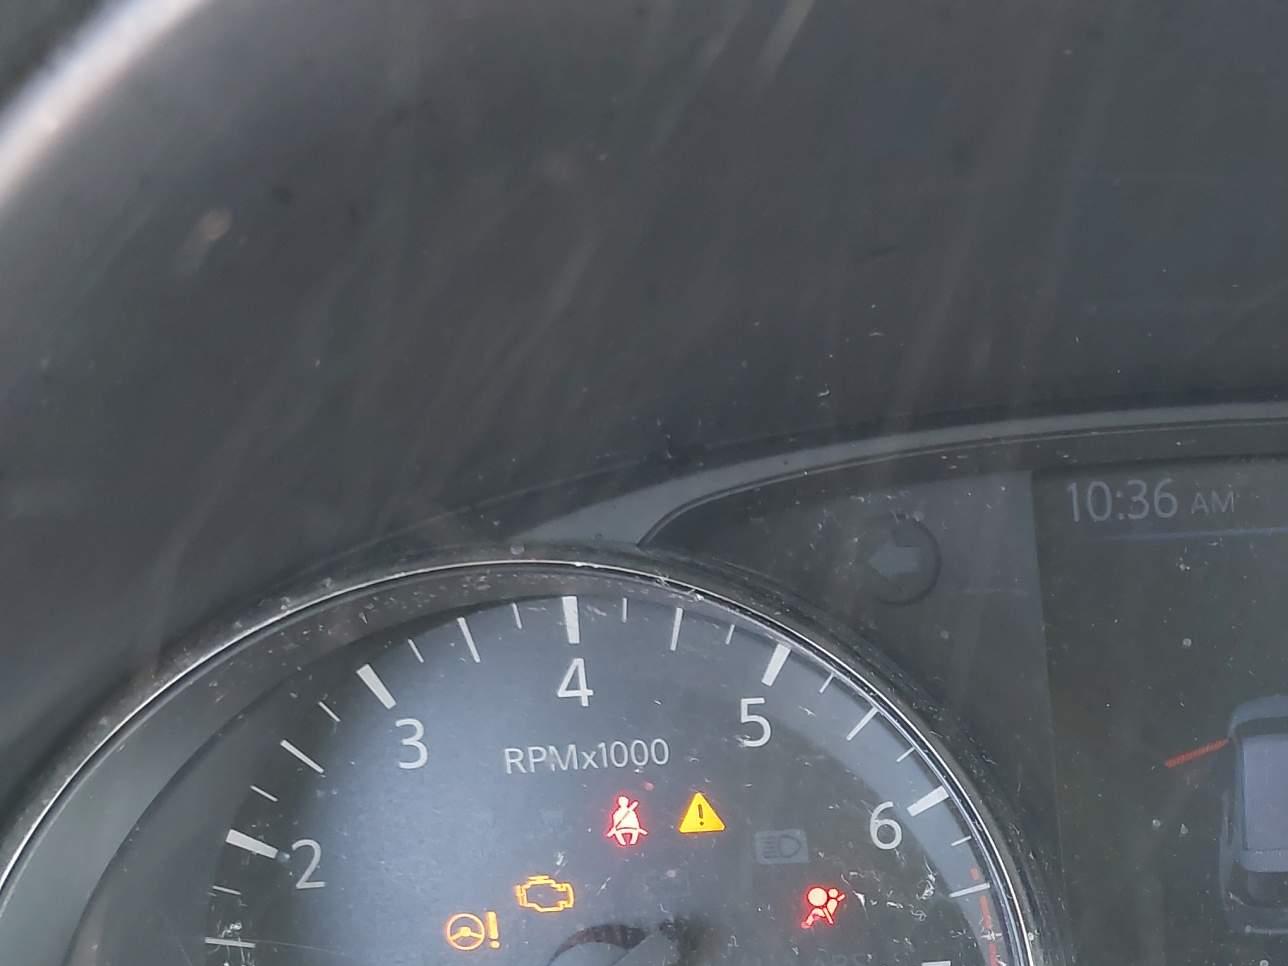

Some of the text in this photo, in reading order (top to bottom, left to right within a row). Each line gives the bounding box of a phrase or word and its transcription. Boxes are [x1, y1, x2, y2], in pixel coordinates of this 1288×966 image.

[1066, 478, 1236, 522] 10:36 AM
[556, 658, 595, 707] 4
[395, 717, 429, 770] 3
[739, 697, 772, 748] 5
[503, 738, 670, 775] RPMx1000
[869, 801, 903, 850] 6
[291, 839, 326, 890] 2
